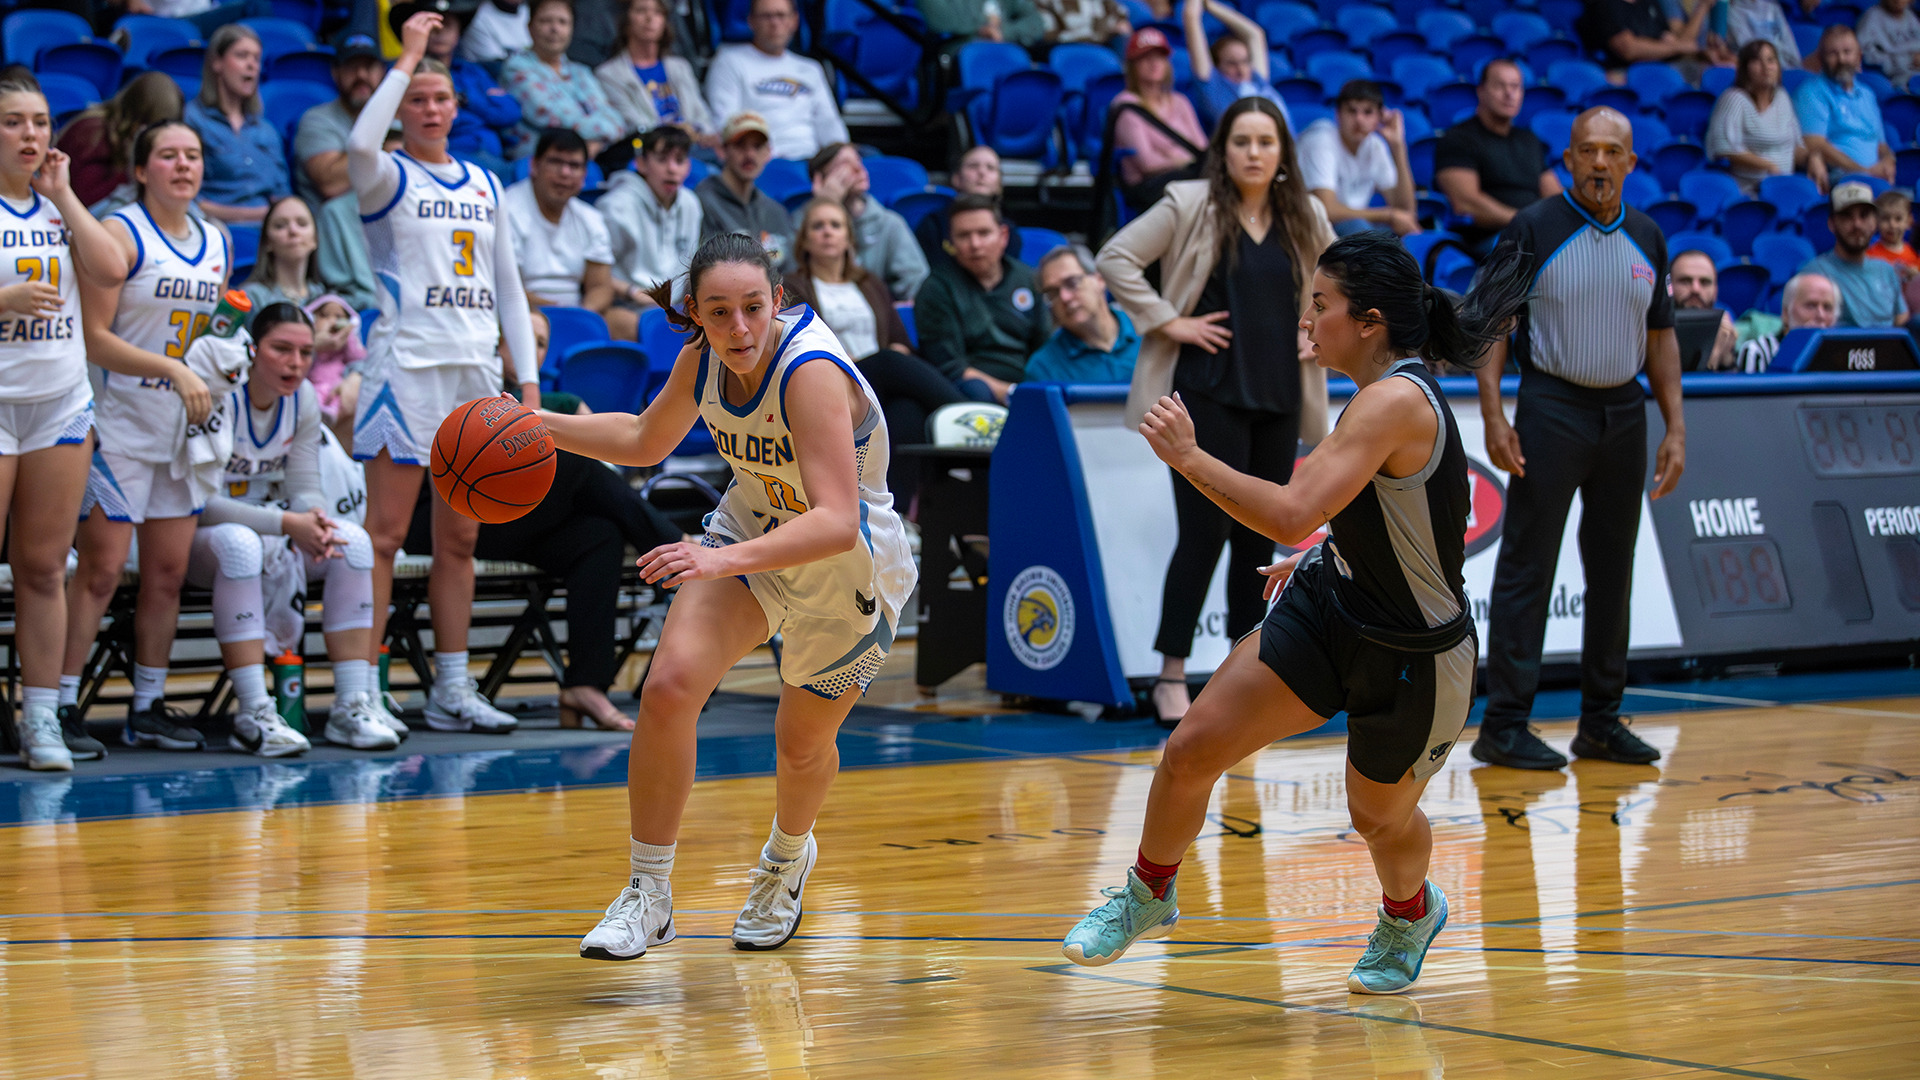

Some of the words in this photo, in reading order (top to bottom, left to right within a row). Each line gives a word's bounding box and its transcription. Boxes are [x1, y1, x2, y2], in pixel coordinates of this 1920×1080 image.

[452, 229, 476, 277] 3
[155, 277, 218, 303] GOLDE
[425, 286, 494, 311] EAGLES
[0, 316, 74, 342] EAGLES
[1847, 348, 1876, 371] POSS
[1689, 497, 1765, 538] HOME
